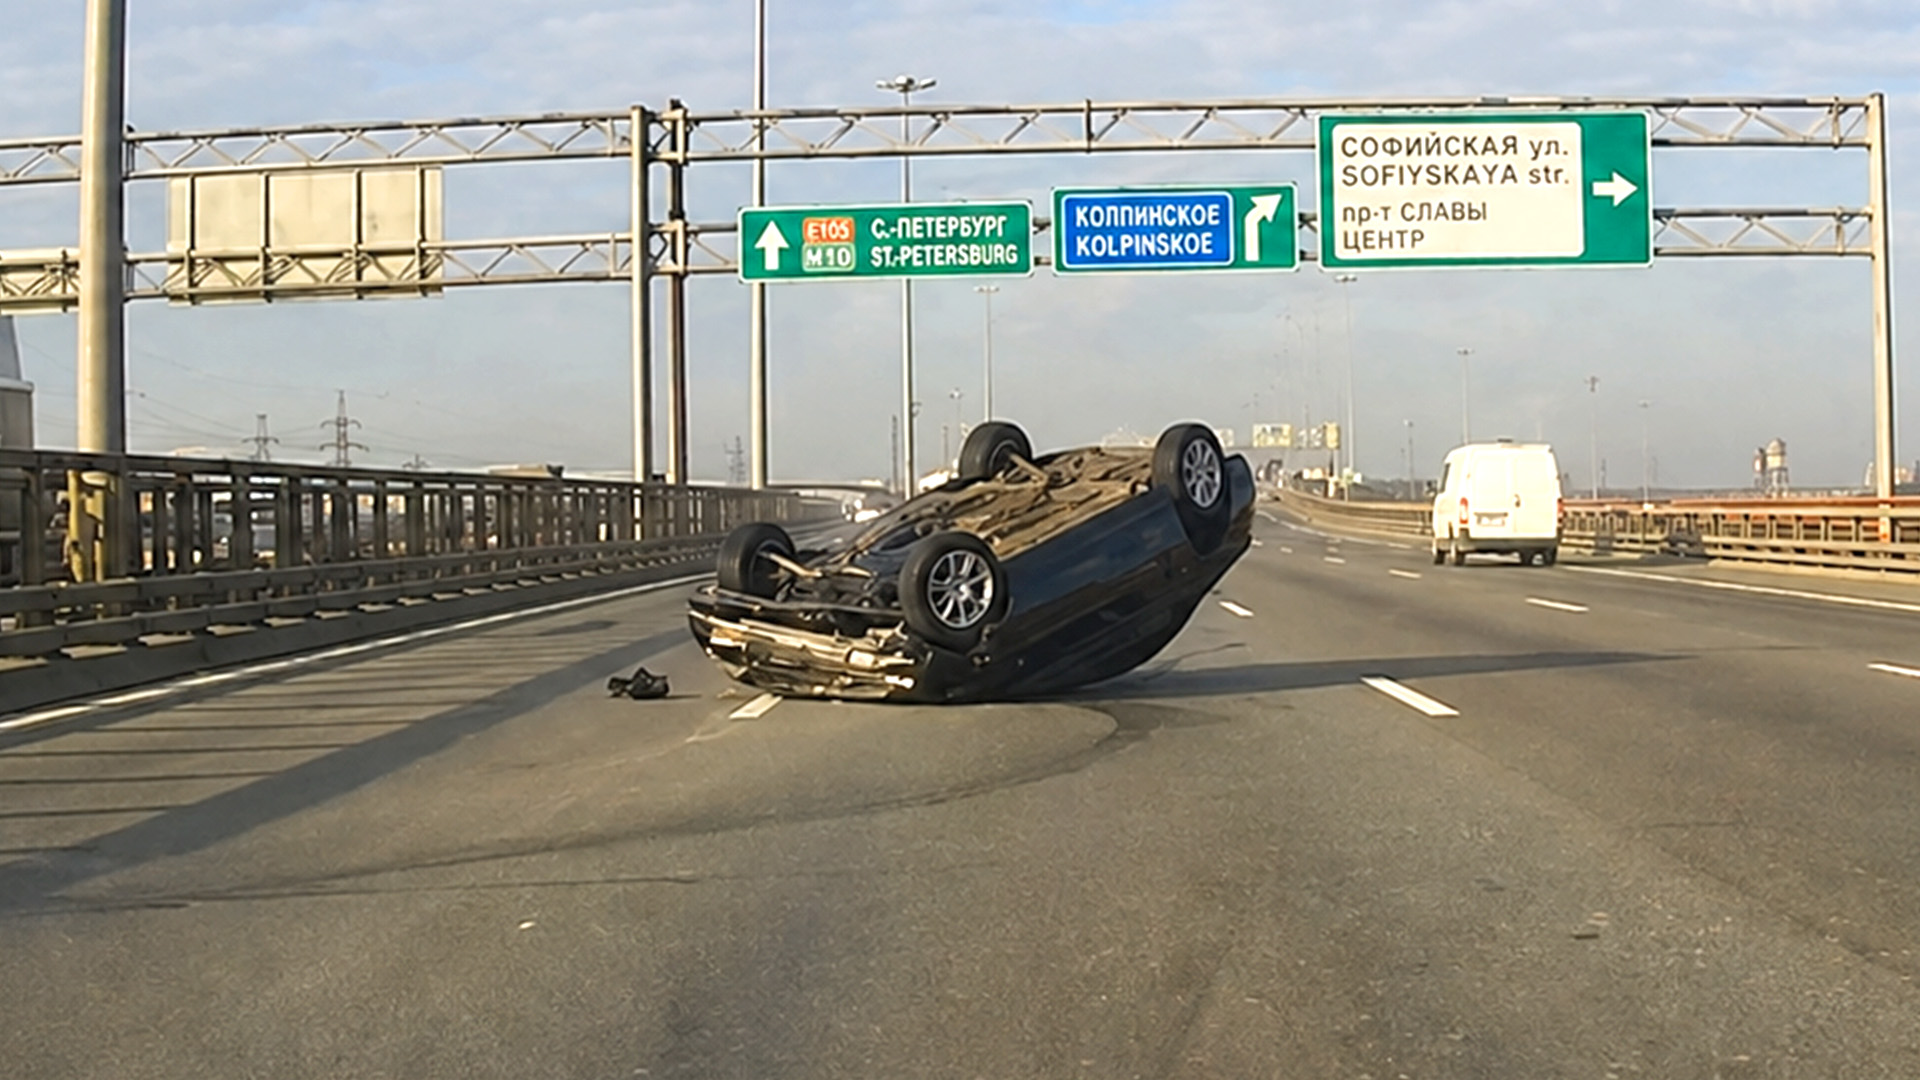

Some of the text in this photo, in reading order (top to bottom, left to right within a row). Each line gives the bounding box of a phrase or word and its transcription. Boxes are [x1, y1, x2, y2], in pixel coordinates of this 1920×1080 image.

[1341, 131, 1569, 161] СОФИЙСКАЯ ул.
[1342, 164, 1570, 187] SOFIYSKAYA str.
[1076, 203, 1220, 228] КОЛПИНСКОЕ
[1343, 201, 1488, 227] пр-т СЛАВЫ
[870, 215, 1007, 240] С.-ПЕТЕРБУРГ
[1076, 231, 1213, 257] KOLPINSKOE
[1343, 229, 1425, 253] ЦЕНТР
